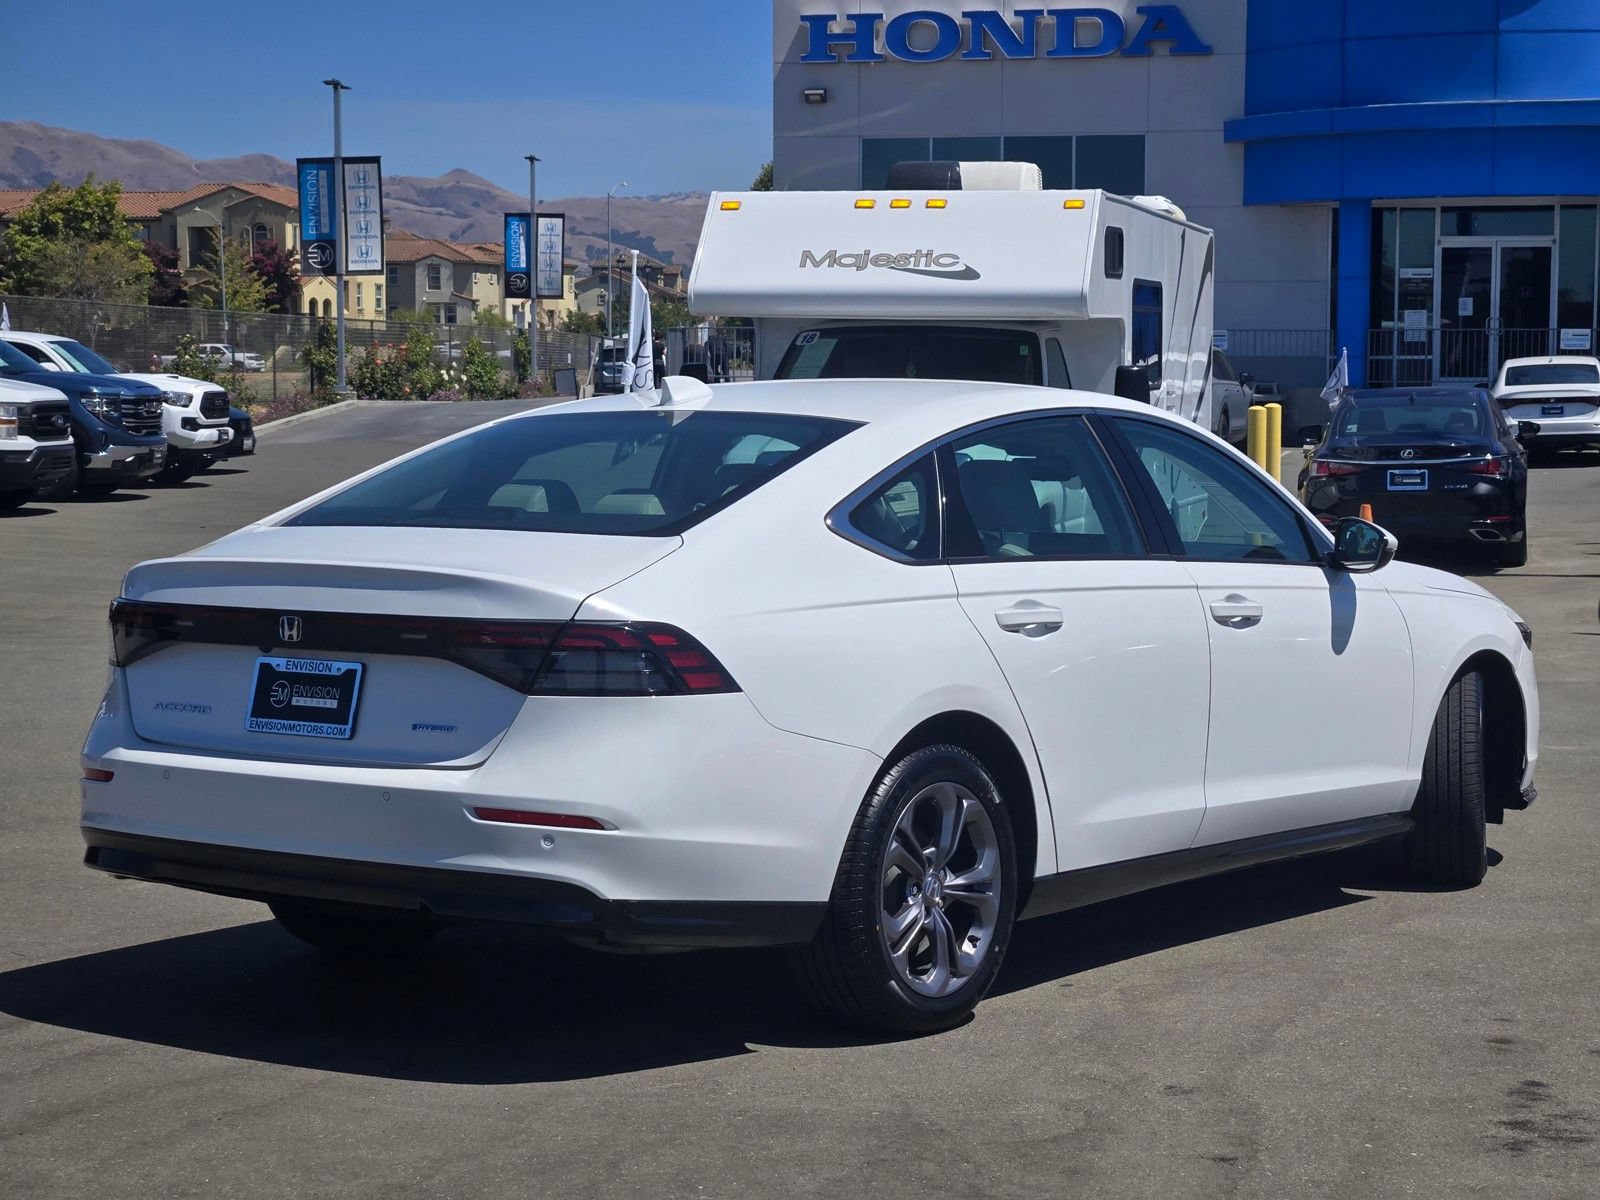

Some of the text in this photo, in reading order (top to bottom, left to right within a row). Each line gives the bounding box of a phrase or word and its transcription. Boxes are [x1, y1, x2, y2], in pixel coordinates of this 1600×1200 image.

[799, 4, 1213, 63] HONDA
[307, 169, 320, 234] ENVISION
[511, 221, 520, 268] ENVISION
[799, 249, 961, 272] Majestic
[800, 332, 818, 344] 18
[284, 660, 333, 673] ENVISION
[292, 684, 341, 699] ENVISION
[152, 701, 213, 713] ACCORD
[295, 699, 335, 707] MOTORS
[249, 720, 347, 737] ENVISIONMOTORS.COM
